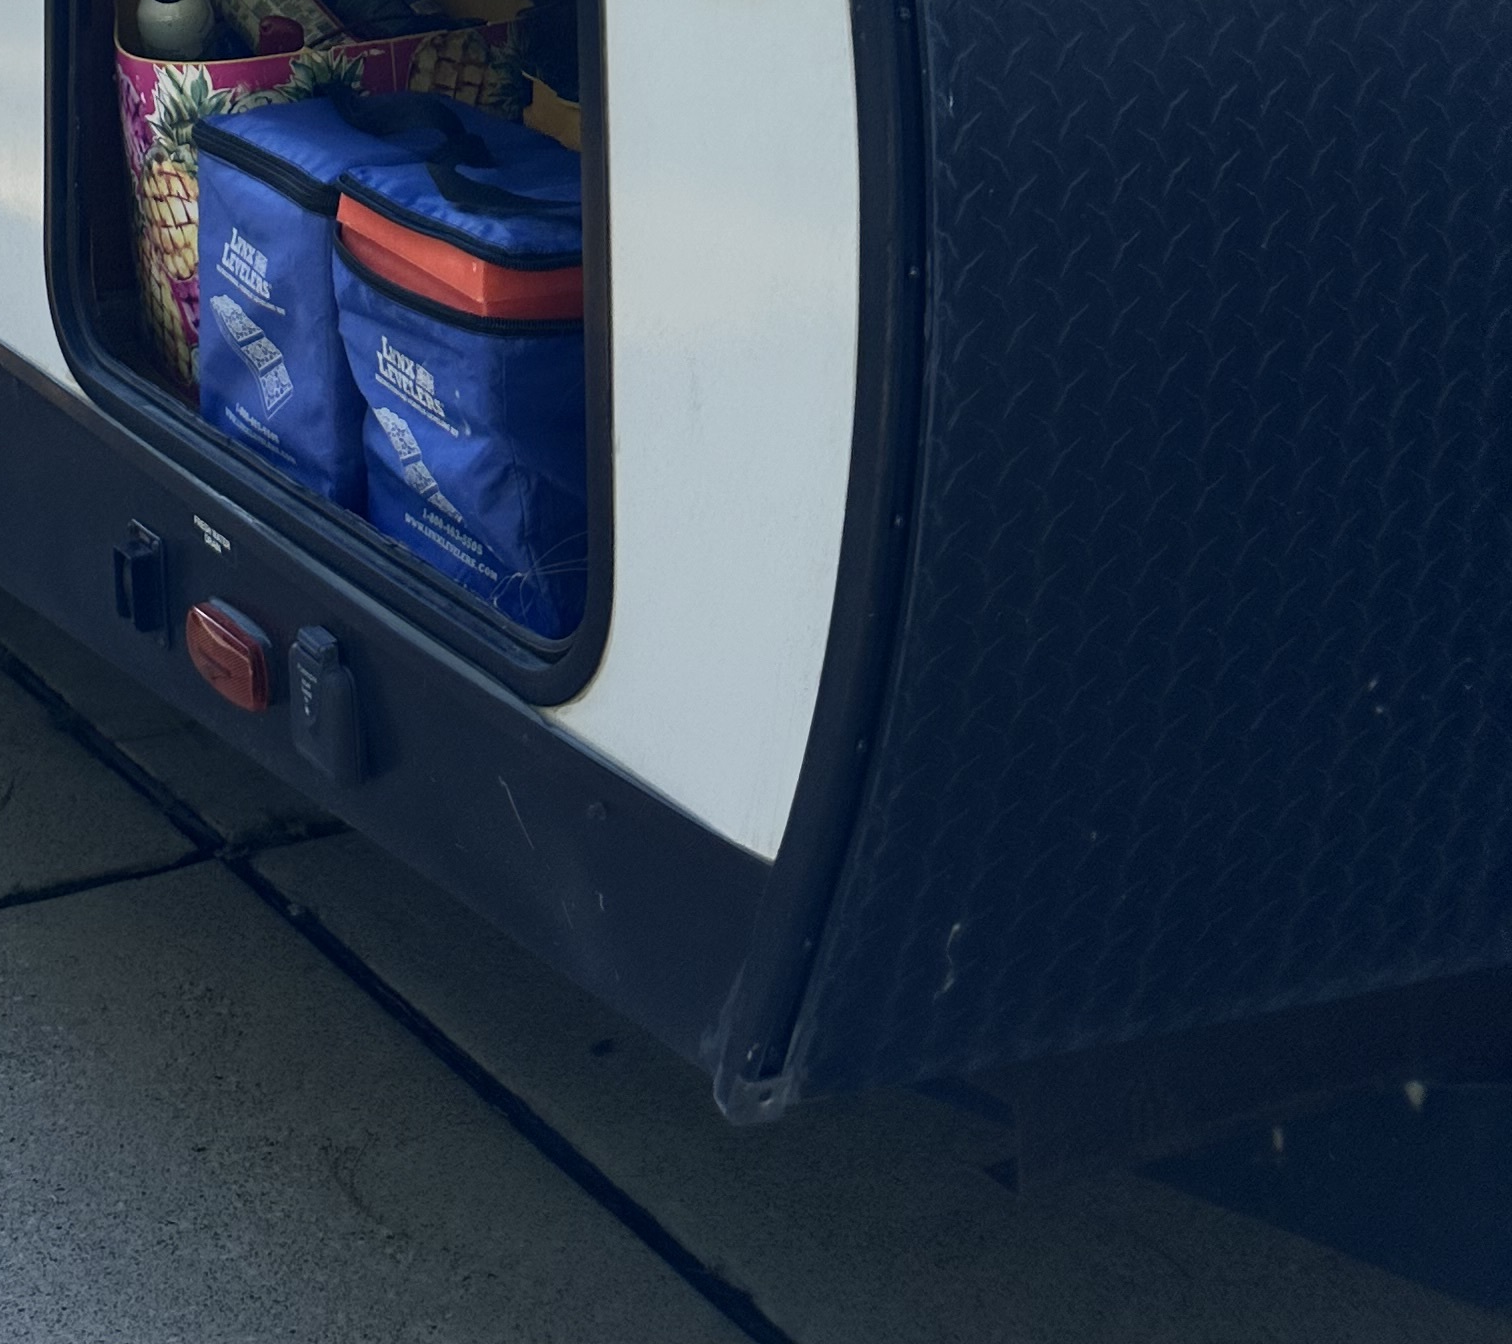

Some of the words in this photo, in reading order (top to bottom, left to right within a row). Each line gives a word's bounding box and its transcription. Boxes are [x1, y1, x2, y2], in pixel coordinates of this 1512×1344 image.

[221, 242, 268, 299] LEVELERS
[230, 227, 256, 265] LYNX
[381, 335, 415, 380] LYNX
[376, 350, 445, 418] LEVELERS
